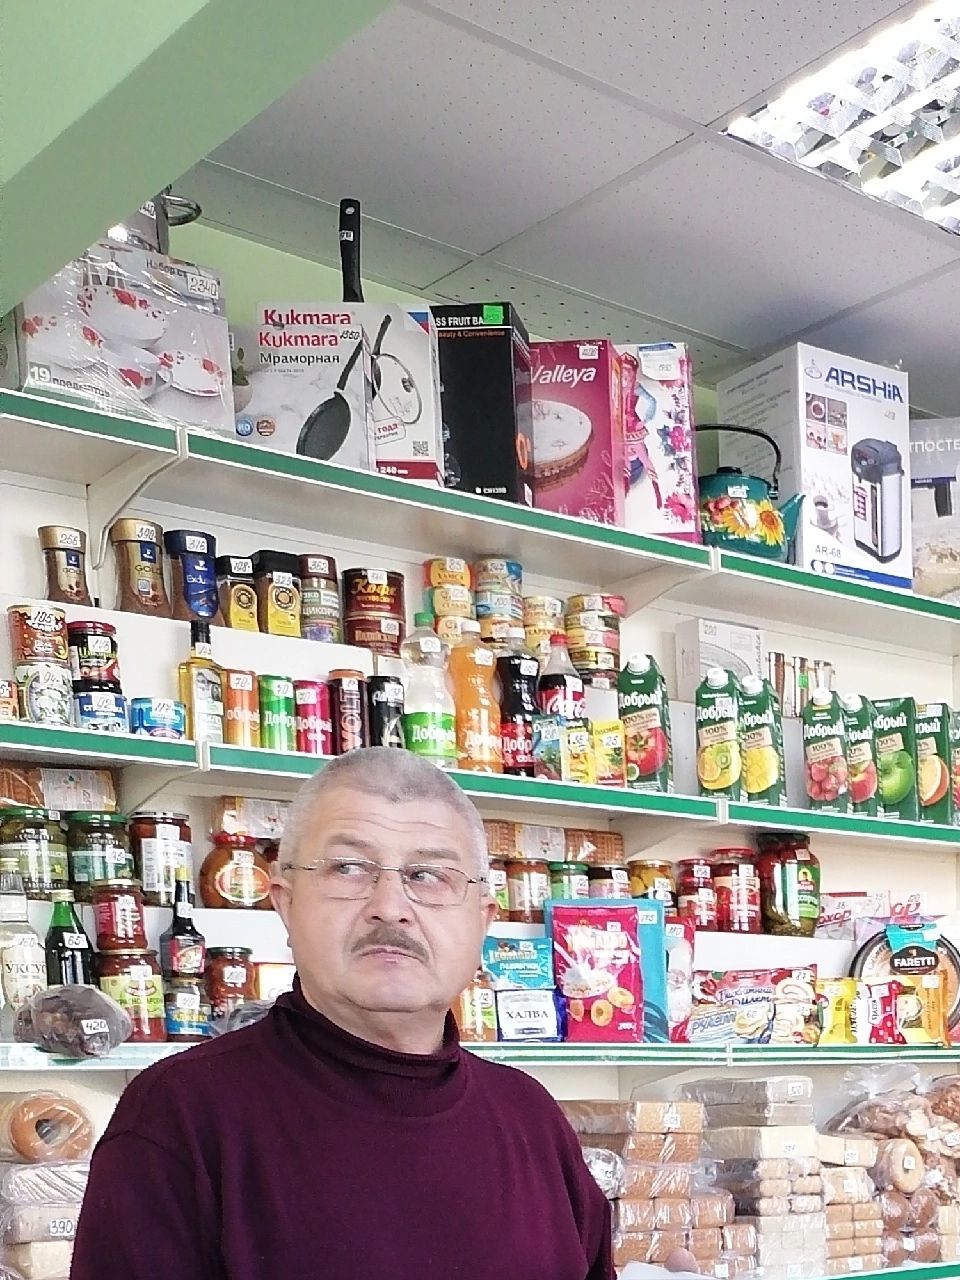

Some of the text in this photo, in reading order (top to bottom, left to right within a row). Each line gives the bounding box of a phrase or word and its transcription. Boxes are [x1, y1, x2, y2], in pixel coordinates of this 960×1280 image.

[264, 309, 351, 325] Kukmara
[449, 316, 468, 327] FRUIT
[470, 315, 484, 326] BA
[259, 331, 338, 348] Kukmara
[260, 352, 340, 367] Мраморная
[30, 366, 51, 383] 19
[530, 364, 597, 388] Valleya
[618, 691, 662, 709] Добрый
[705, 726, 727, 736] 100%
[812, 742, 834, 753] 100%
[893, 956, 936, 969] FARETTI
[505, 1010, 549, 1020] ХАЛВА
[85, 1021, 107, 1031] 420
[50, 1219, 74, 1235] 390
